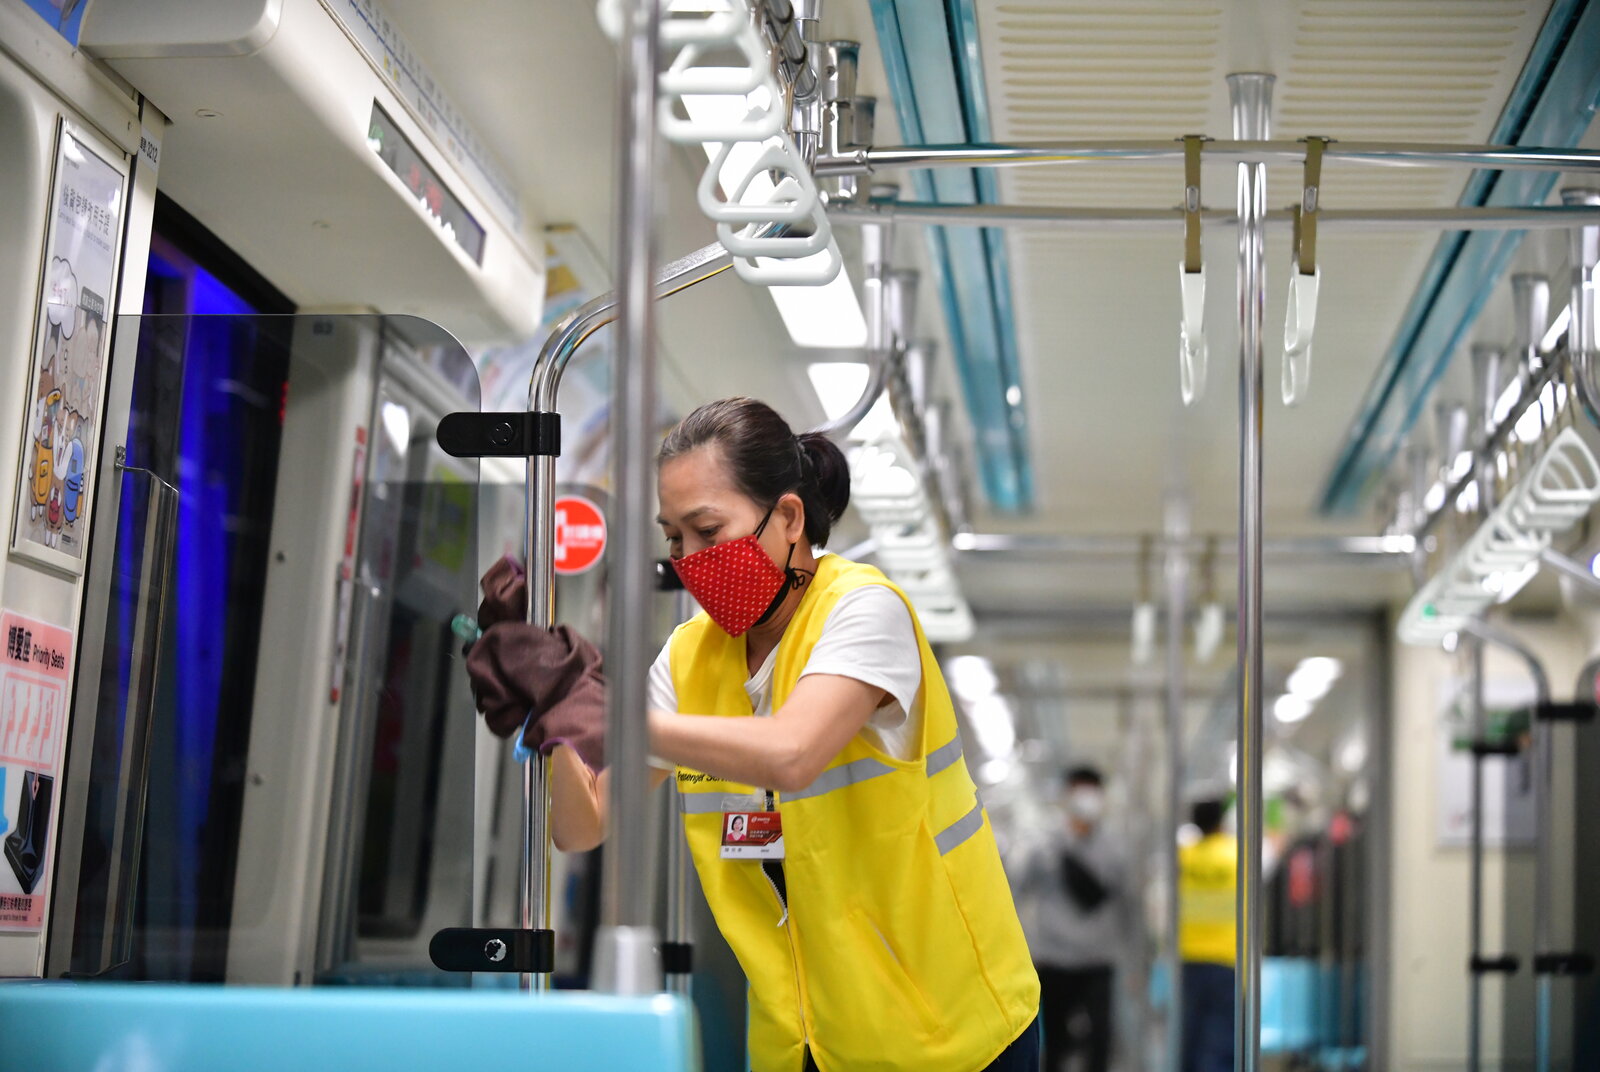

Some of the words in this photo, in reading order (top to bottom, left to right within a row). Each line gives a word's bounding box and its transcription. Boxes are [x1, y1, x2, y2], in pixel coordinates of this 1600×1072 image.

[147, 141, 158, 163] 3212
[7, 625, 32, 662] 博愛座
[33, 644, 50, 670] Priority
[51, 649, 65, 669] Seats
